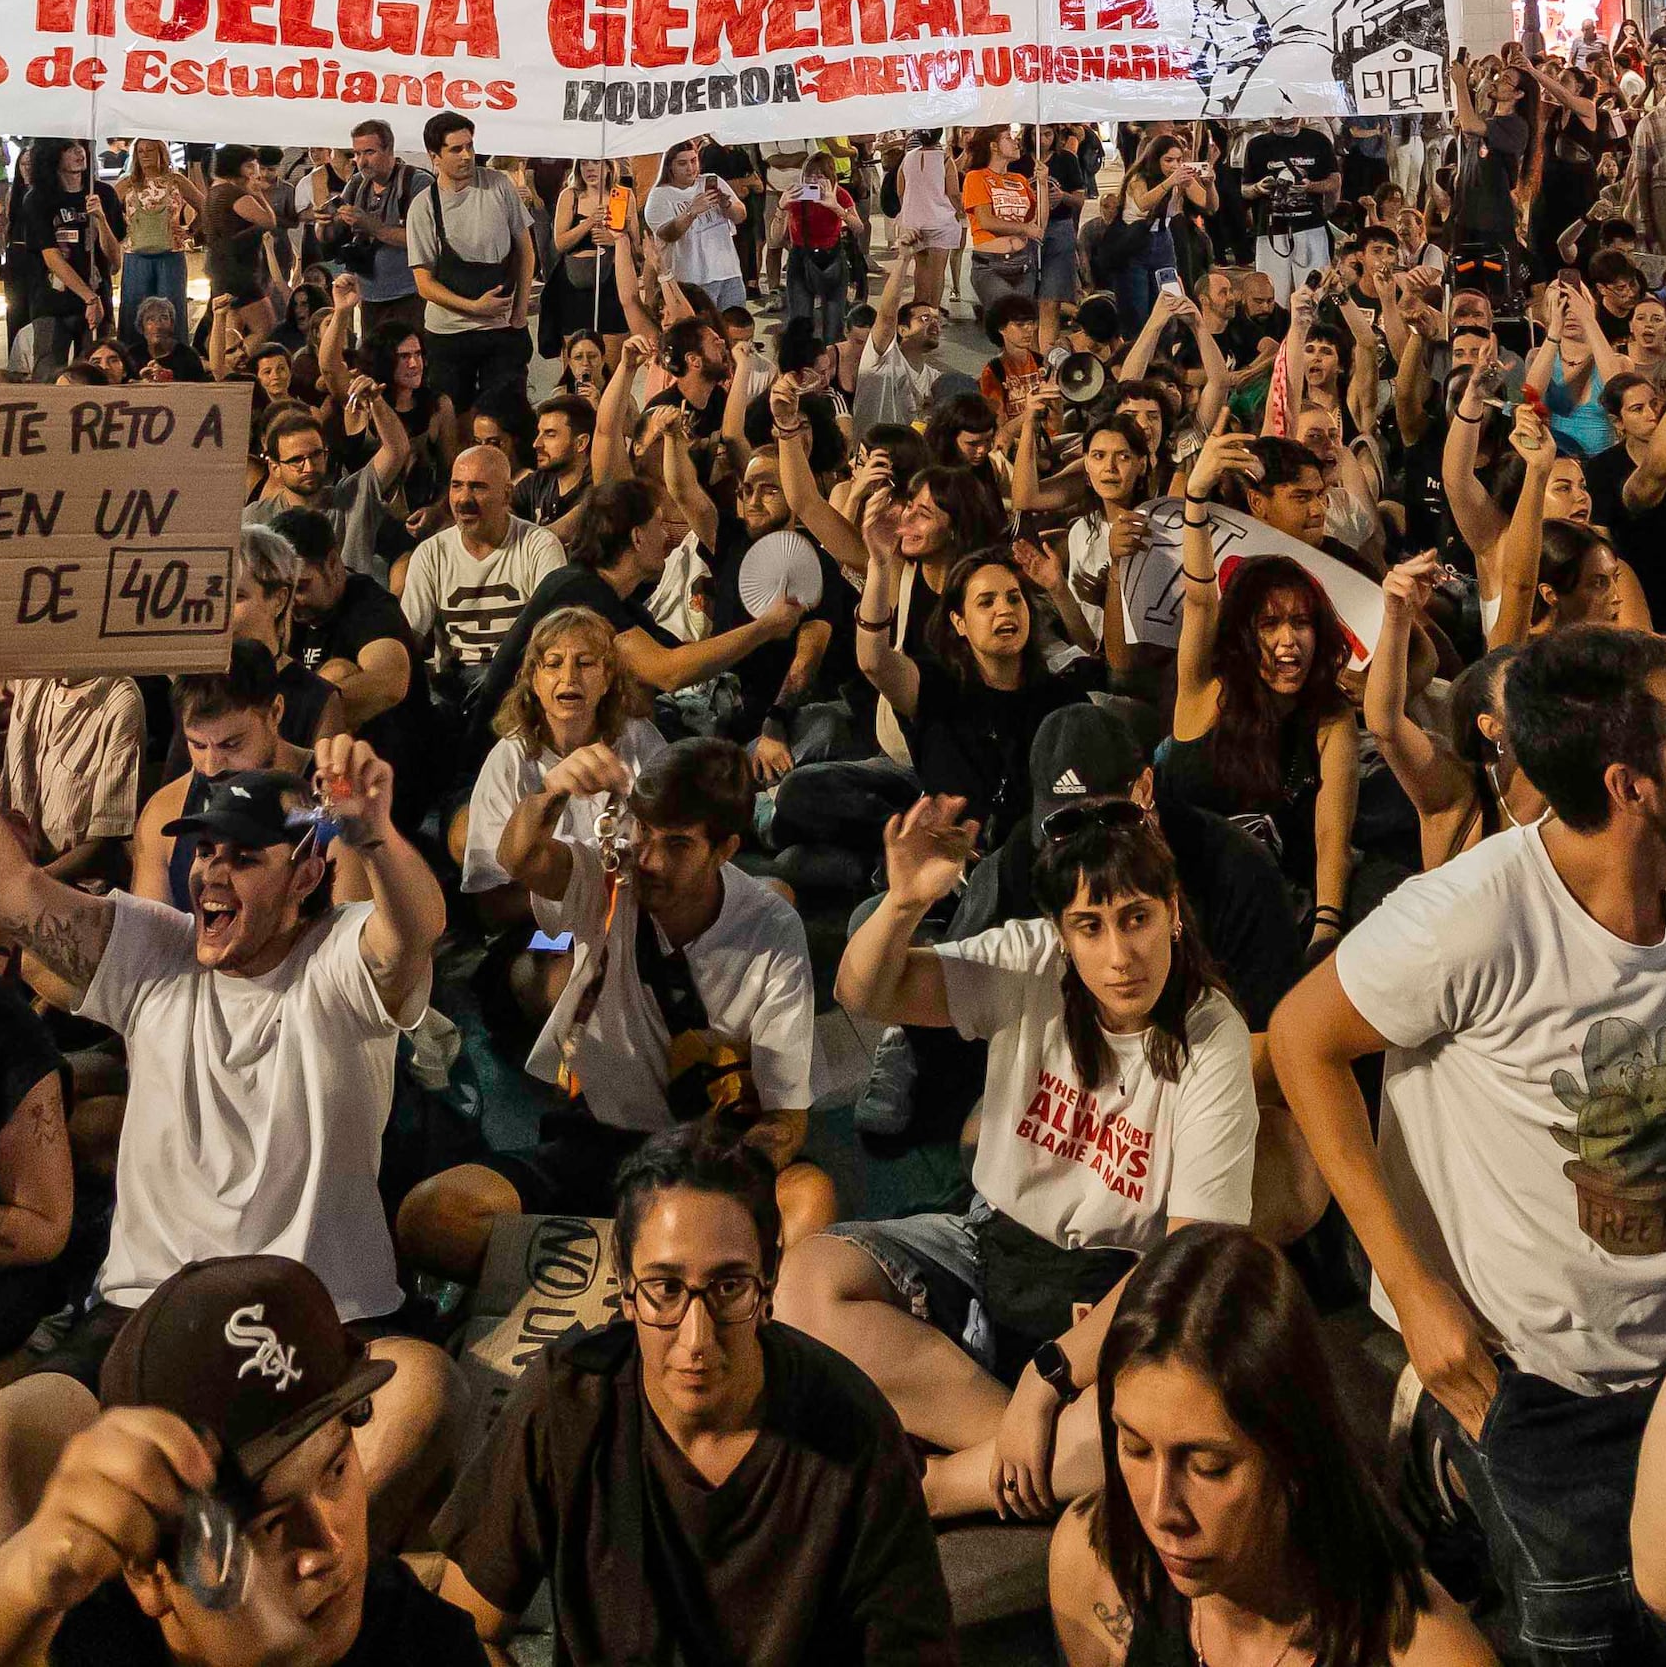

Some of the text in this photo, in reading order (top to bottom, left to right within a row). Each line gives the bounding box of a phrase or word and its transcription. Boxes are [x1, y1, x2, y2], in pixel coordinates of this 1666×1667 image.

[26, 48, 110, 92] de
[122, 49, 520, 111] Estudiantes
[563, 64, 802, 127] IZQUIERDA
[71, 400, 177, 455] RETO
[193, 403, 223, 449] A
[95, 488, 179, 541] UN
[17, 564, 81, 624] DE
[1053, 785, 1087, 794] adidas
[1026, 1089, 1150, 1179] ALWAYS
[1037, 1068, 1089, 1110] WHEN
[1103, 1113, 1154, 1149] DOUBT
[1016, 1118, 1144, 1203] BLAME A MAN
[1584, 1197, 1654, 1243] FREE
[533, 1219, 597, 1291] NO
[225, 1302, 303, 1393] Sox
